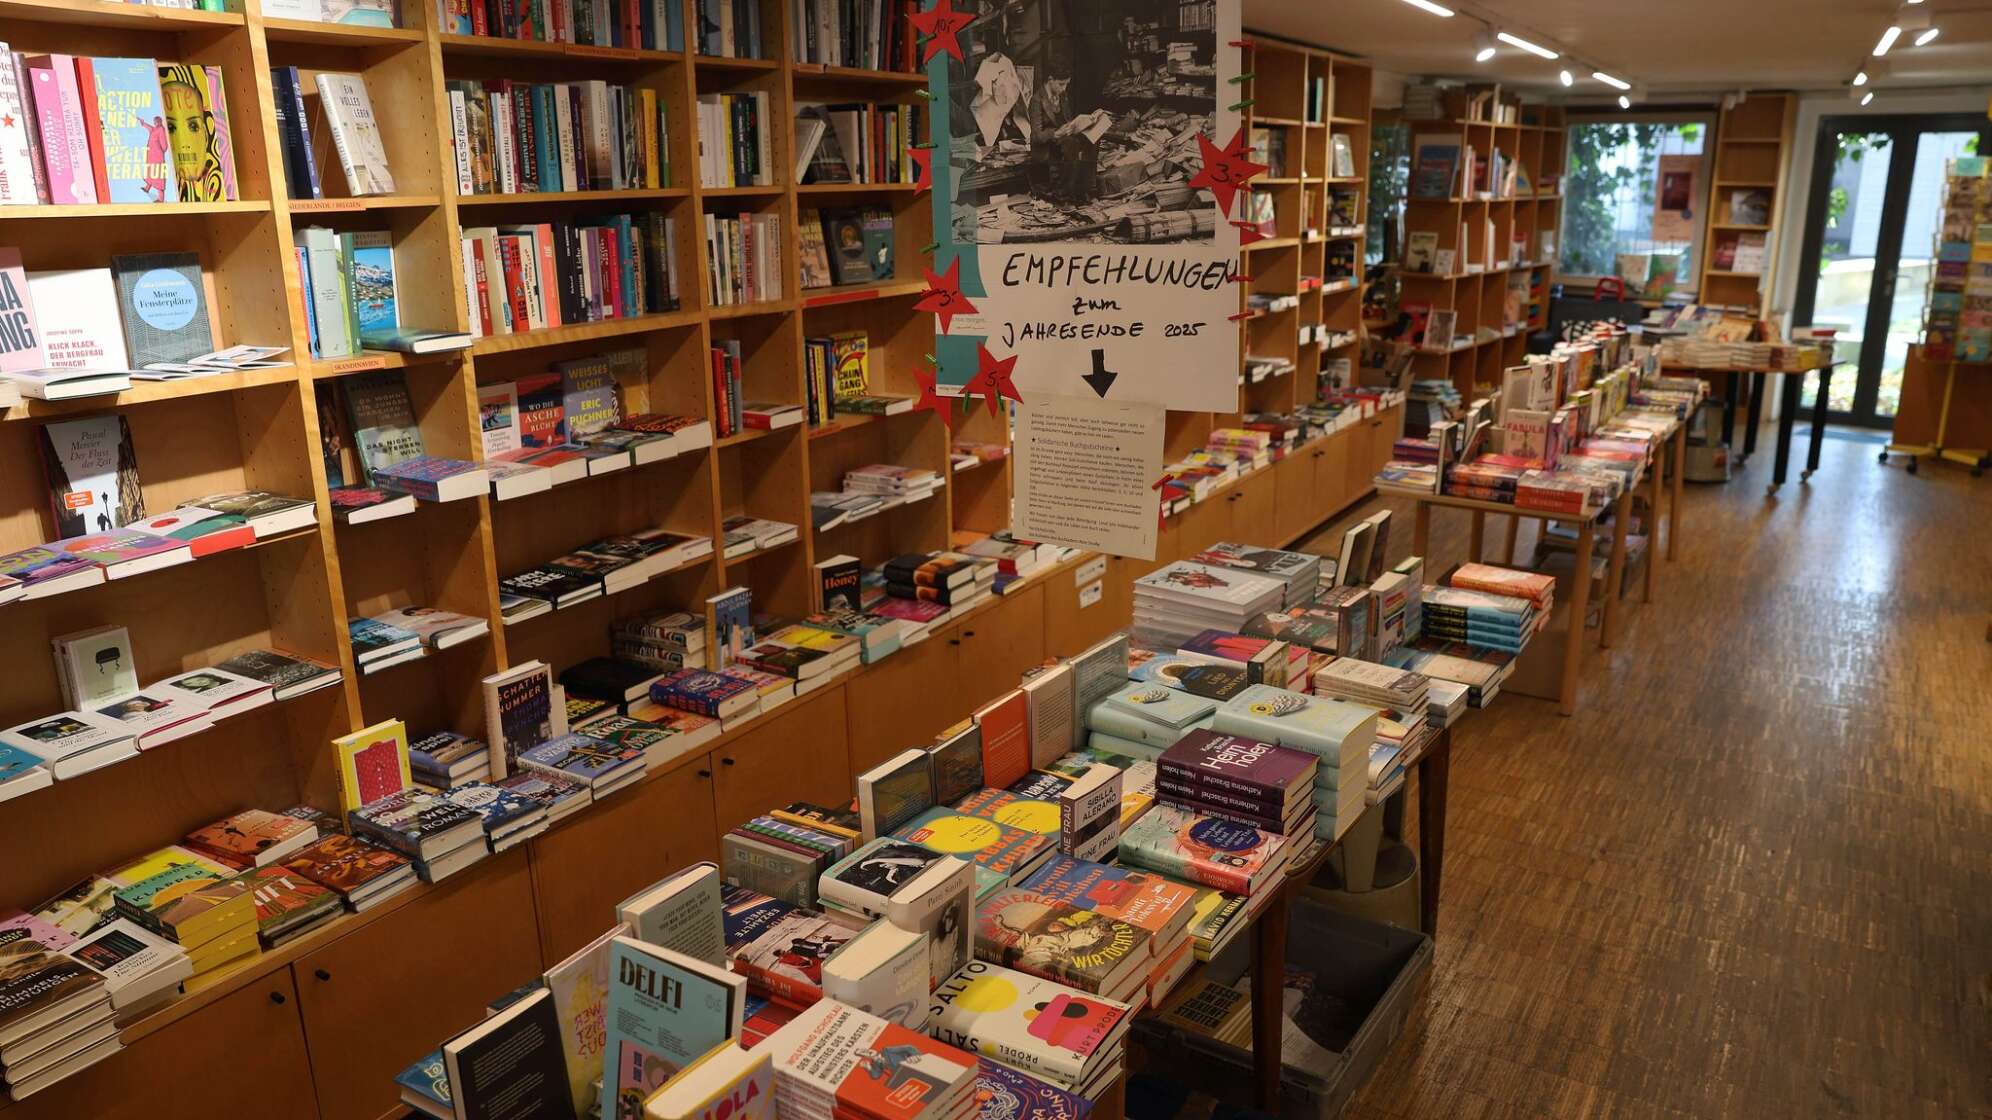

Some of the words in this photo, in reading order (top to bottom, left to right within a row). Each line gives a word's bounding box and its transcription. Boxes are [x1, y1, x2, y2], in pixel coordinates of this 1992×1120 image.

[343, 85, 354, 95] EIN
[1002, 253, 1238, 290] EMPFEHLUNGEN
[139, 296, 194, 309] Fensterplätze
[152, 290, 178, 299] Meine
[1073, 297, 1122, 316] zum
[48, 342, 70, 350] KLICK
[1001, 322, 1145, 349] JAHRESENDE
[1164, 322, 1207, 337] 2025
[50, 351, 65, 360] DER
[66, 350, 104, 359] BERGFRAU
[334, 360, 379, 371] SKANDINAVIEN
[568, 363, 609, 379] WEISSES
[838, 380, 861, 391] GANG
[581, 398, 601, 411] ERIC
[569, 409, 614, 426] PUCHNER
[1507, 422, 1545, 434] FABULA
[81, 428, 106, 441] Pascal
[70, 449, 85, 461] Der
[824, 575, 857, 589] Honey
[1200, 744, 1247, 769] Heim
[1236, 742, 1273, 768] holen
[1083, 793, 1117, 821] ALERAMO
[1087, 786, 1113, 810] SIBILLA
[421, 804, 461, 821] WELT
[422, 809, 470, 831] ROMAN
[1063, 804, 1072, 834] FRAU
[132, 869, 203, 902] KLAPPER
[734, 908, 780, 938] ERZÄHLTE
[742, 909, 768, 925] WELT
[1072, 955, 1105, 969] WIR
[1101, 923, 1134, 961] TÖCHTER
[0, 972, 79, 1010] ICHTUNGEN
[619, 955, 683, 1010] DELFI
[930, 962, 988, 1016] SALTO
[786, 1032, 818, 1066] WOLFGANG
[796, 1057, 809, 1071] DER
[808, 1011, 851, 1058] UNAUFHALTSAME
[933, 1026, 980, 1052] SALT
[808, 1047, 835, 1075] AUFSTIEG
[830, 1035, 846, 1048] DES
[818, 1048, 849, 1079] MINISTERS
[845, 1022, 869, 1048] KARSTEN
[999, 1044, 1039, 1064] PRÖDEL
[829, 1059, 852, 1085] RICHTER
